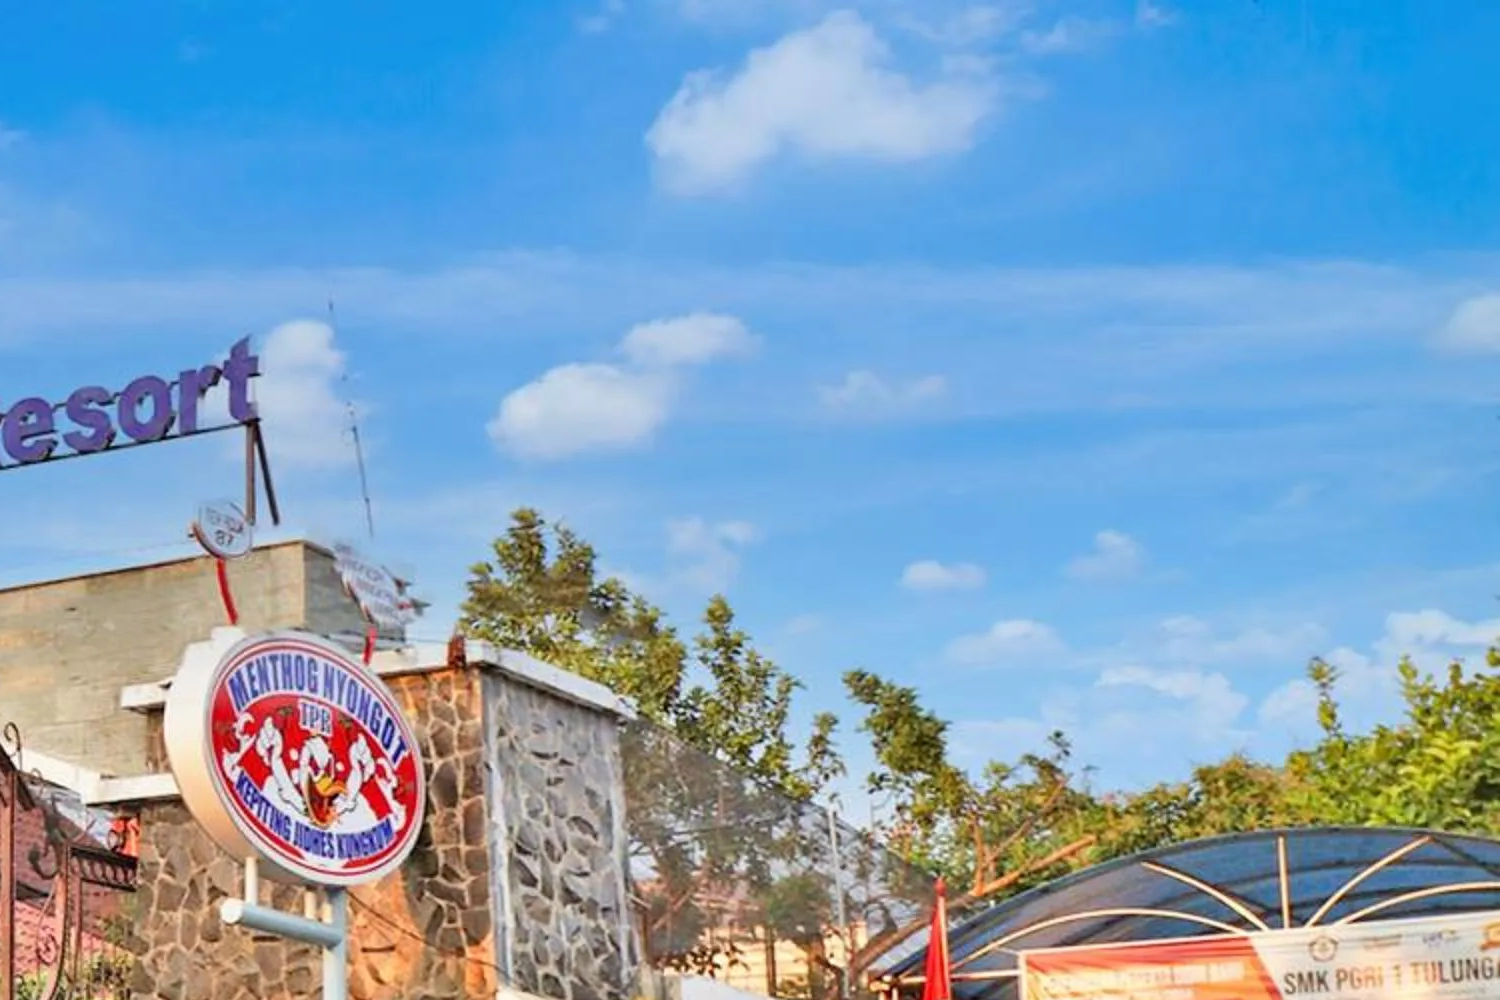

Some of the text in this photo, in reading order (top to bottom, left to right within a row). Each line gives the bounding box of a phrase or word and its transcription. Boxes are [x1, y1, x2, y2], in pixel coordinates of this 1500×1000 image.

[227, 653, 407, 766] MENTHOG NYONGOT
[300, 701, 331, 733] TPR
[235, 771, 292, 842] KEPITING
[1284, 971, 1330, 995] SMK
[1335, 962, 1385, 990] PGRI
[1392, 964, 1403, 986] 1
